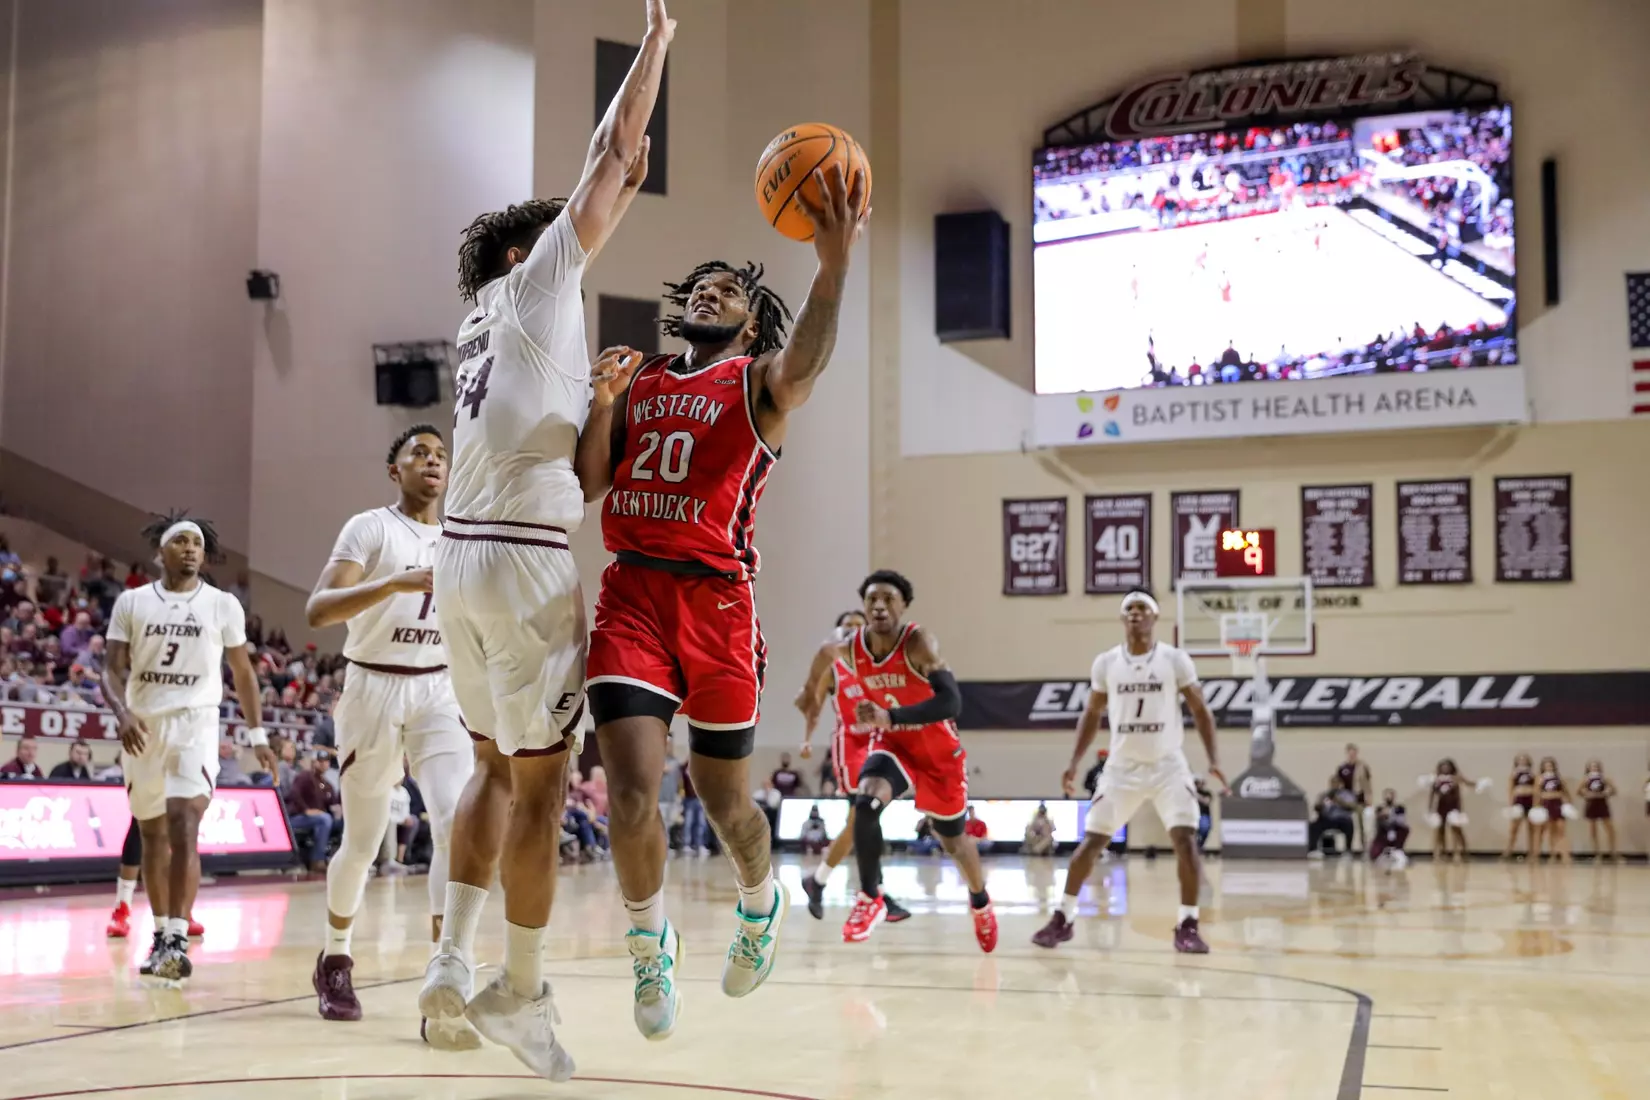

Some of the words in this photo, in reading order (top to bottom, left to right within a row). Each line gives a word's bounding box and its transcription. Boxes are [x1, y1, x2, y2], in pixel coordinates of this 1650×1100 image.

[1105, 62, 1426, 139] COLONELS
[763, 160, 791, 204] EVO
[458, 329, 490, 364] ORENO
[633, 394, 724, 426] WESTERN
[1132, 398, 1242, 426] BAPTIST
[1252, 394, 1365, 420] HEALTH
[1374, 387, 1477, 413] ARENA
[631, 430, 695, 483] 20
[610, 490, 707, 524] KENTUCKY
[1010, 532, 1058, 562] 627
[1095, 524, 1139, 560] 40
[1244, 546, 1263, 574] 9
[145, 624, 202, 637] EASTERN
[391, 627, 442, 645] KENTU
[161, 642, 179, 666] 3
[140, 671, 201, 686] KENTUCKY
[1030, 682, 1092, 712] EK
[1186, 675, 1540, 711] OLLEYBALL
[41, 710, 87, 737] OF
[1136, 698, 1145, 718] 1
